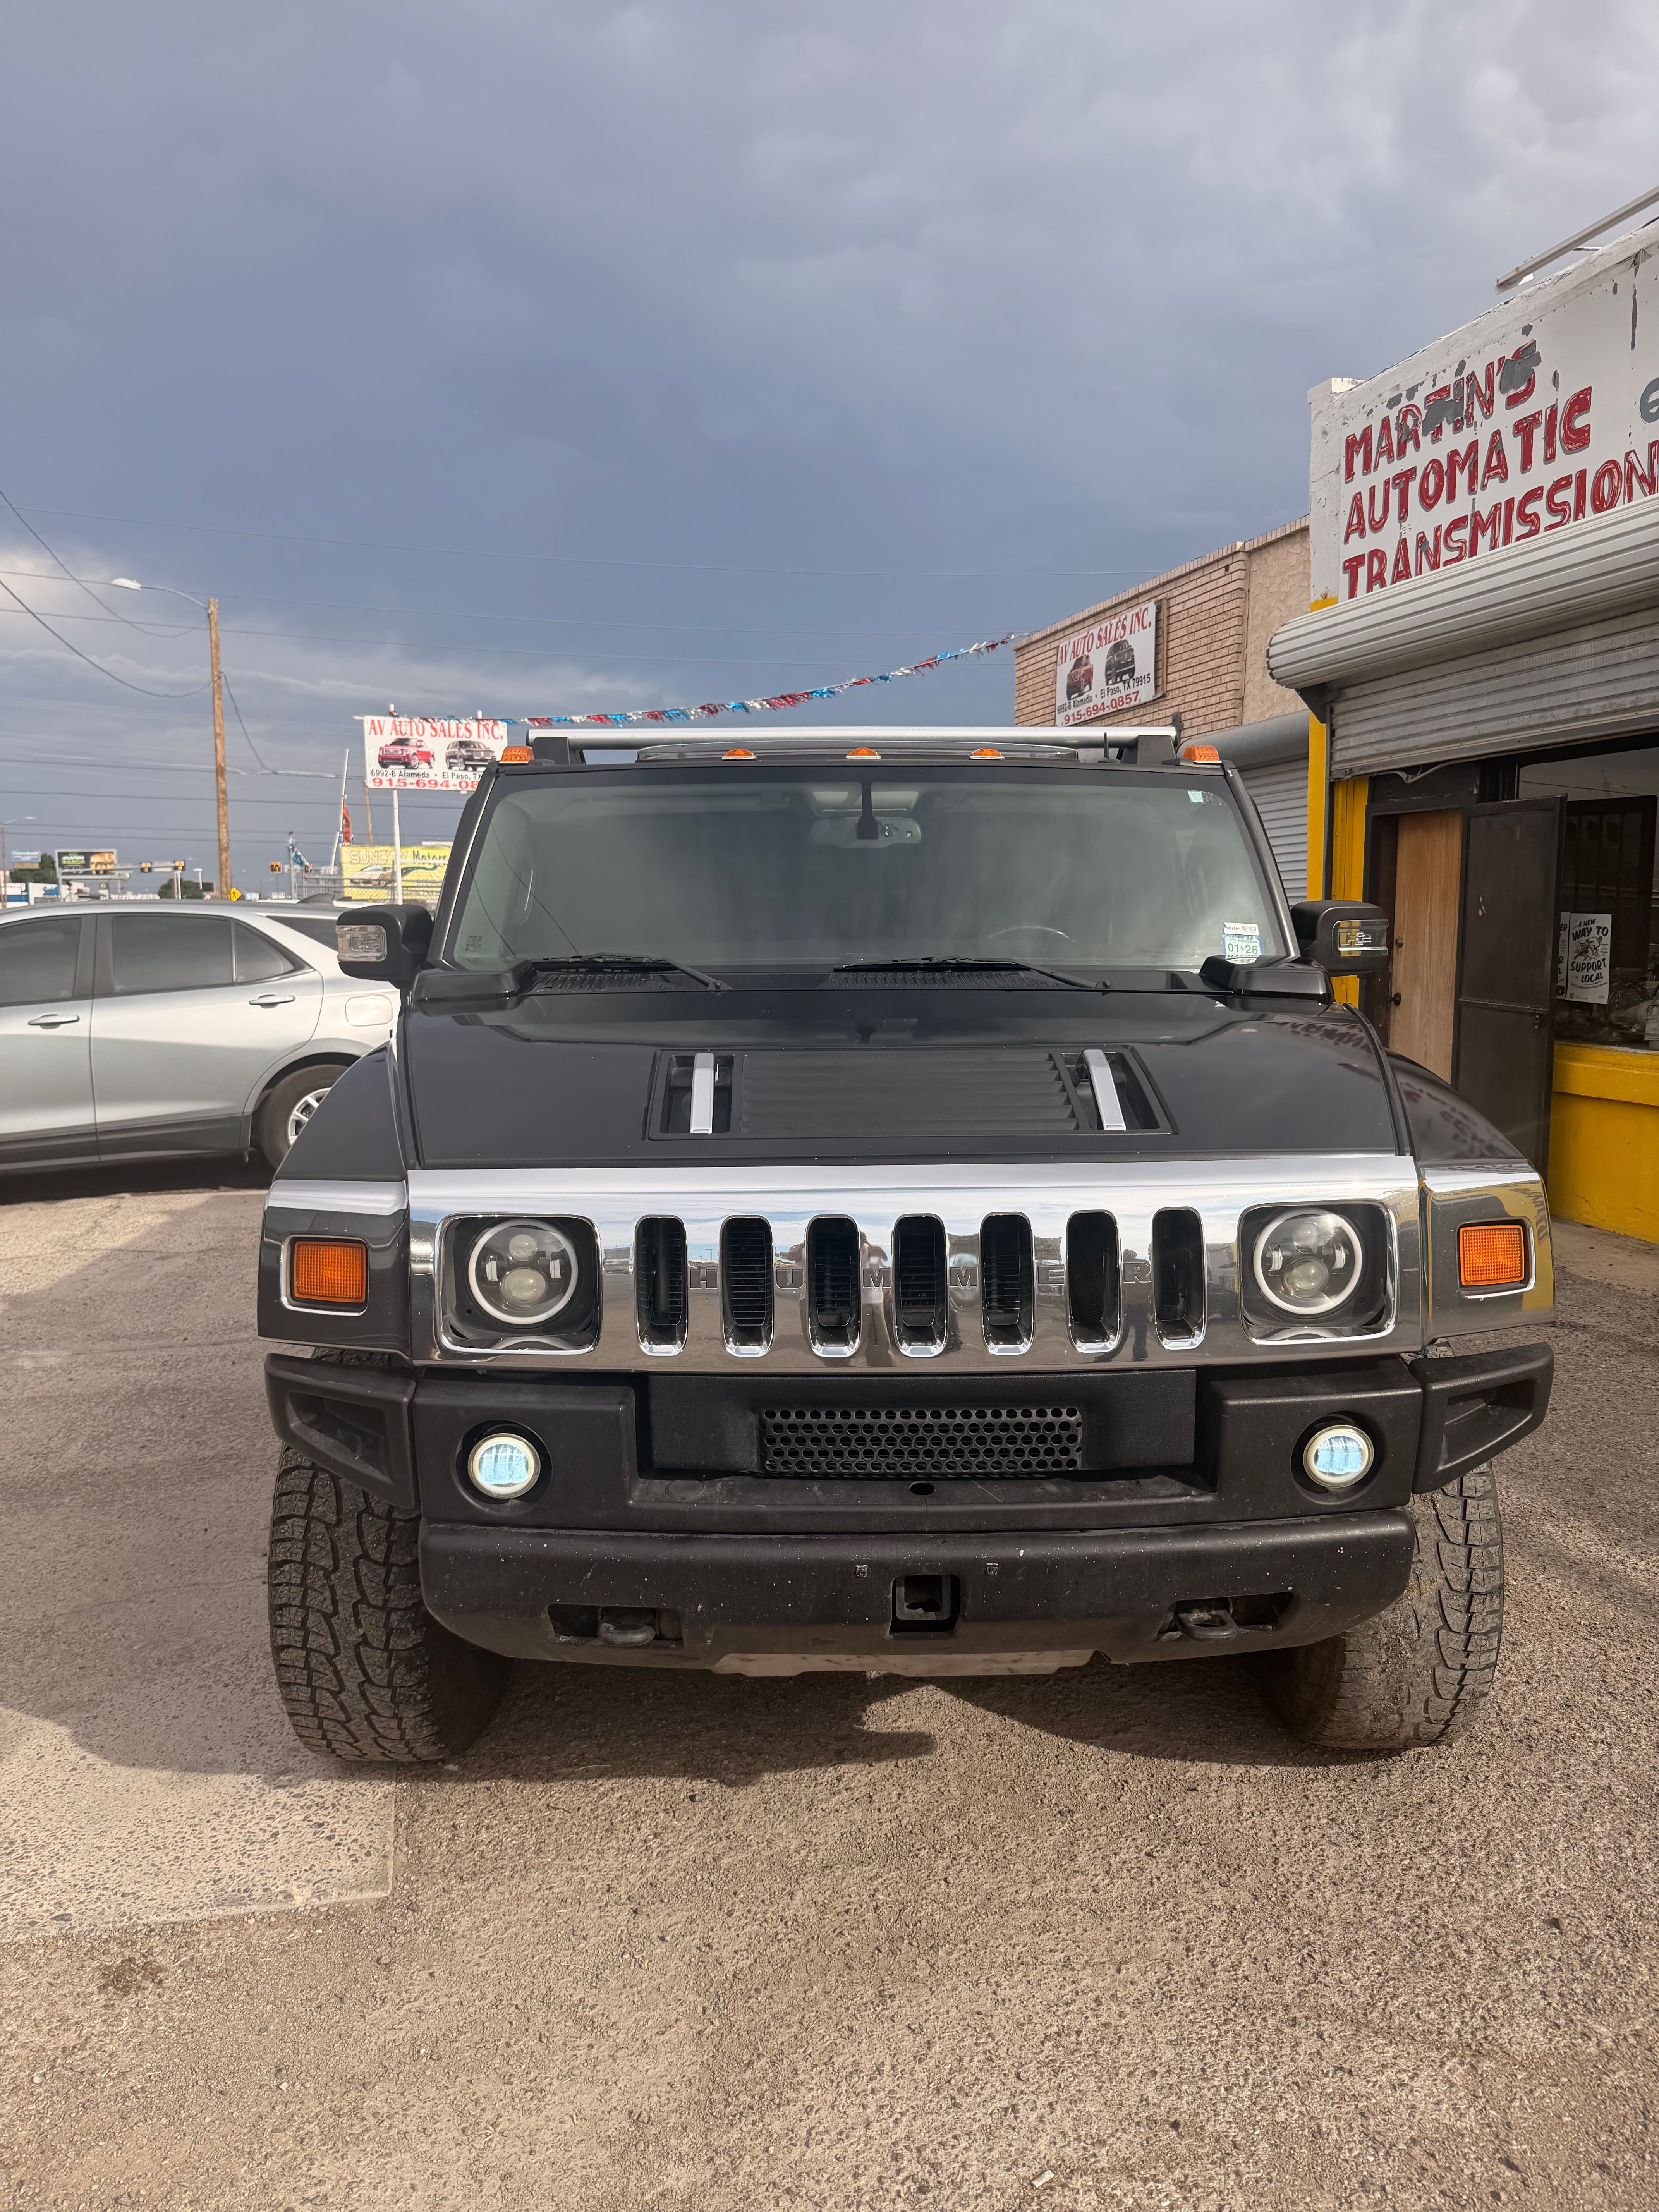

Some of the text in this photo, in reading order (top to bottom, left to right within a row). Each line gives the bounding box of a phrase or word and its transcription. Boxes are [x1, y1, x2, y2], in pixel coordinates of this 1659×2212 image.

[1343, 386, 1592, 544] AUTOMATIC
[1343, 440, 1659, 600] TRANSMISSION
[1058, 607, 1152, 666] AV AUTO SALES INC.
[1057, 673, 1150, 715] 6992-B Alameda El Paso, TX 79915
[1064, 690, 1140, 725] 915-694-0857
[369, 719, 503, 740] AV AUTO SALES INC.
[372, 777, 479, 790] 915-694-08
[399, 770, 430, 778] Alameda
[452, 772, 471, 781] Paso,
[1583, 918, 1596, 926] NEW
[1571, 927, 1592, 941] WAY
[1596, 926, 1609, 937] TO
[1228, 943, 1258, 954] 01 26
[1570, 957, 1606, 973] SUPPORT
[1581, 974, 1603, 982] LOCAL
